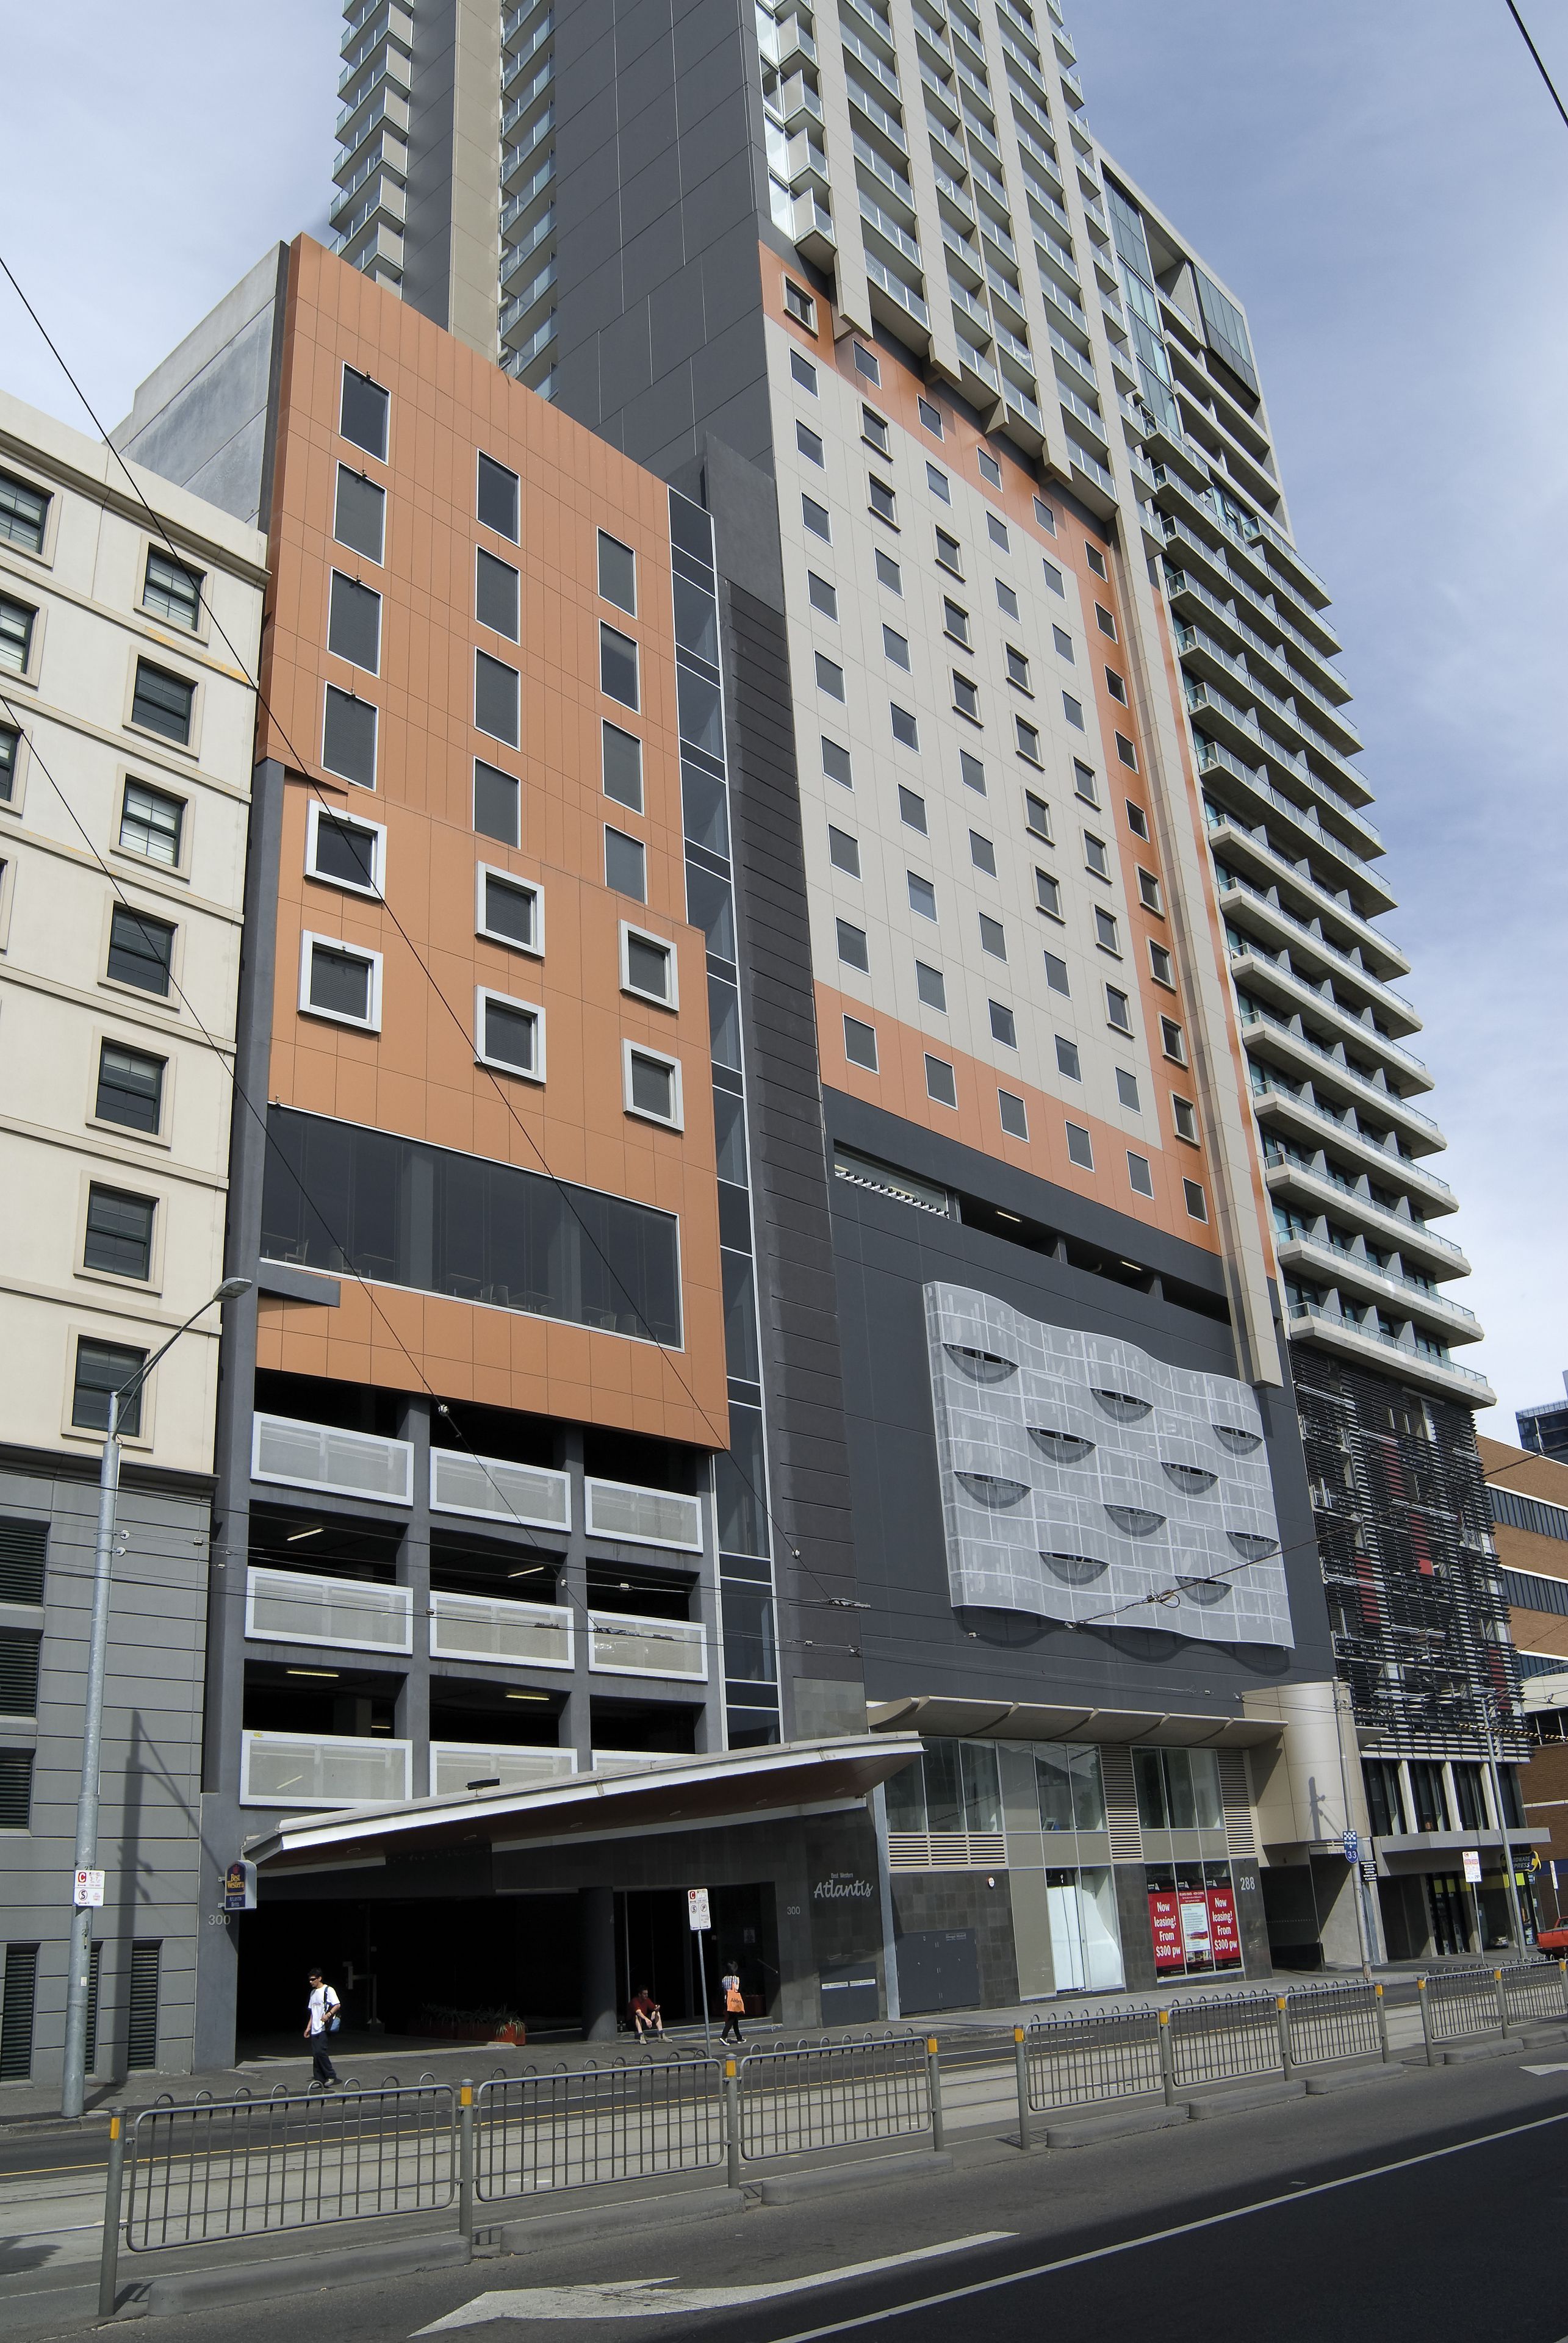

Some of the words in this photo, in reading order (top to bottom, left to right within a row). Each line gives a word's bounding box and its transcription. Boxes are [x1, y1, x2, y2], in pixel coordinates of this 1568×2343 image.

[814, 1879, 873, 1898] Atlantis
[1240, 1876, 1255, 1890] 288
[1157, 1902, 1170, 1912] Now
[1215, 1898, 1227, 1907] Now
[787, 1906, 800, 1915] 300
[208, 1915, 231, 1925] 300
[1212, 1910, 1233, 1923] leasing!
[1154, 1916, 1176, 1929] leasing!
[1217, 1926, 1231, 1935] From
[1159, 1931, 1174, 1942] From
[1215, 1939, 1228, 1950] $300
[1229, 1940, 1237, 1951] pw
[1156, 1945, 1171, 1957] $300
[1173, 1946, 1181, 1958] pw
